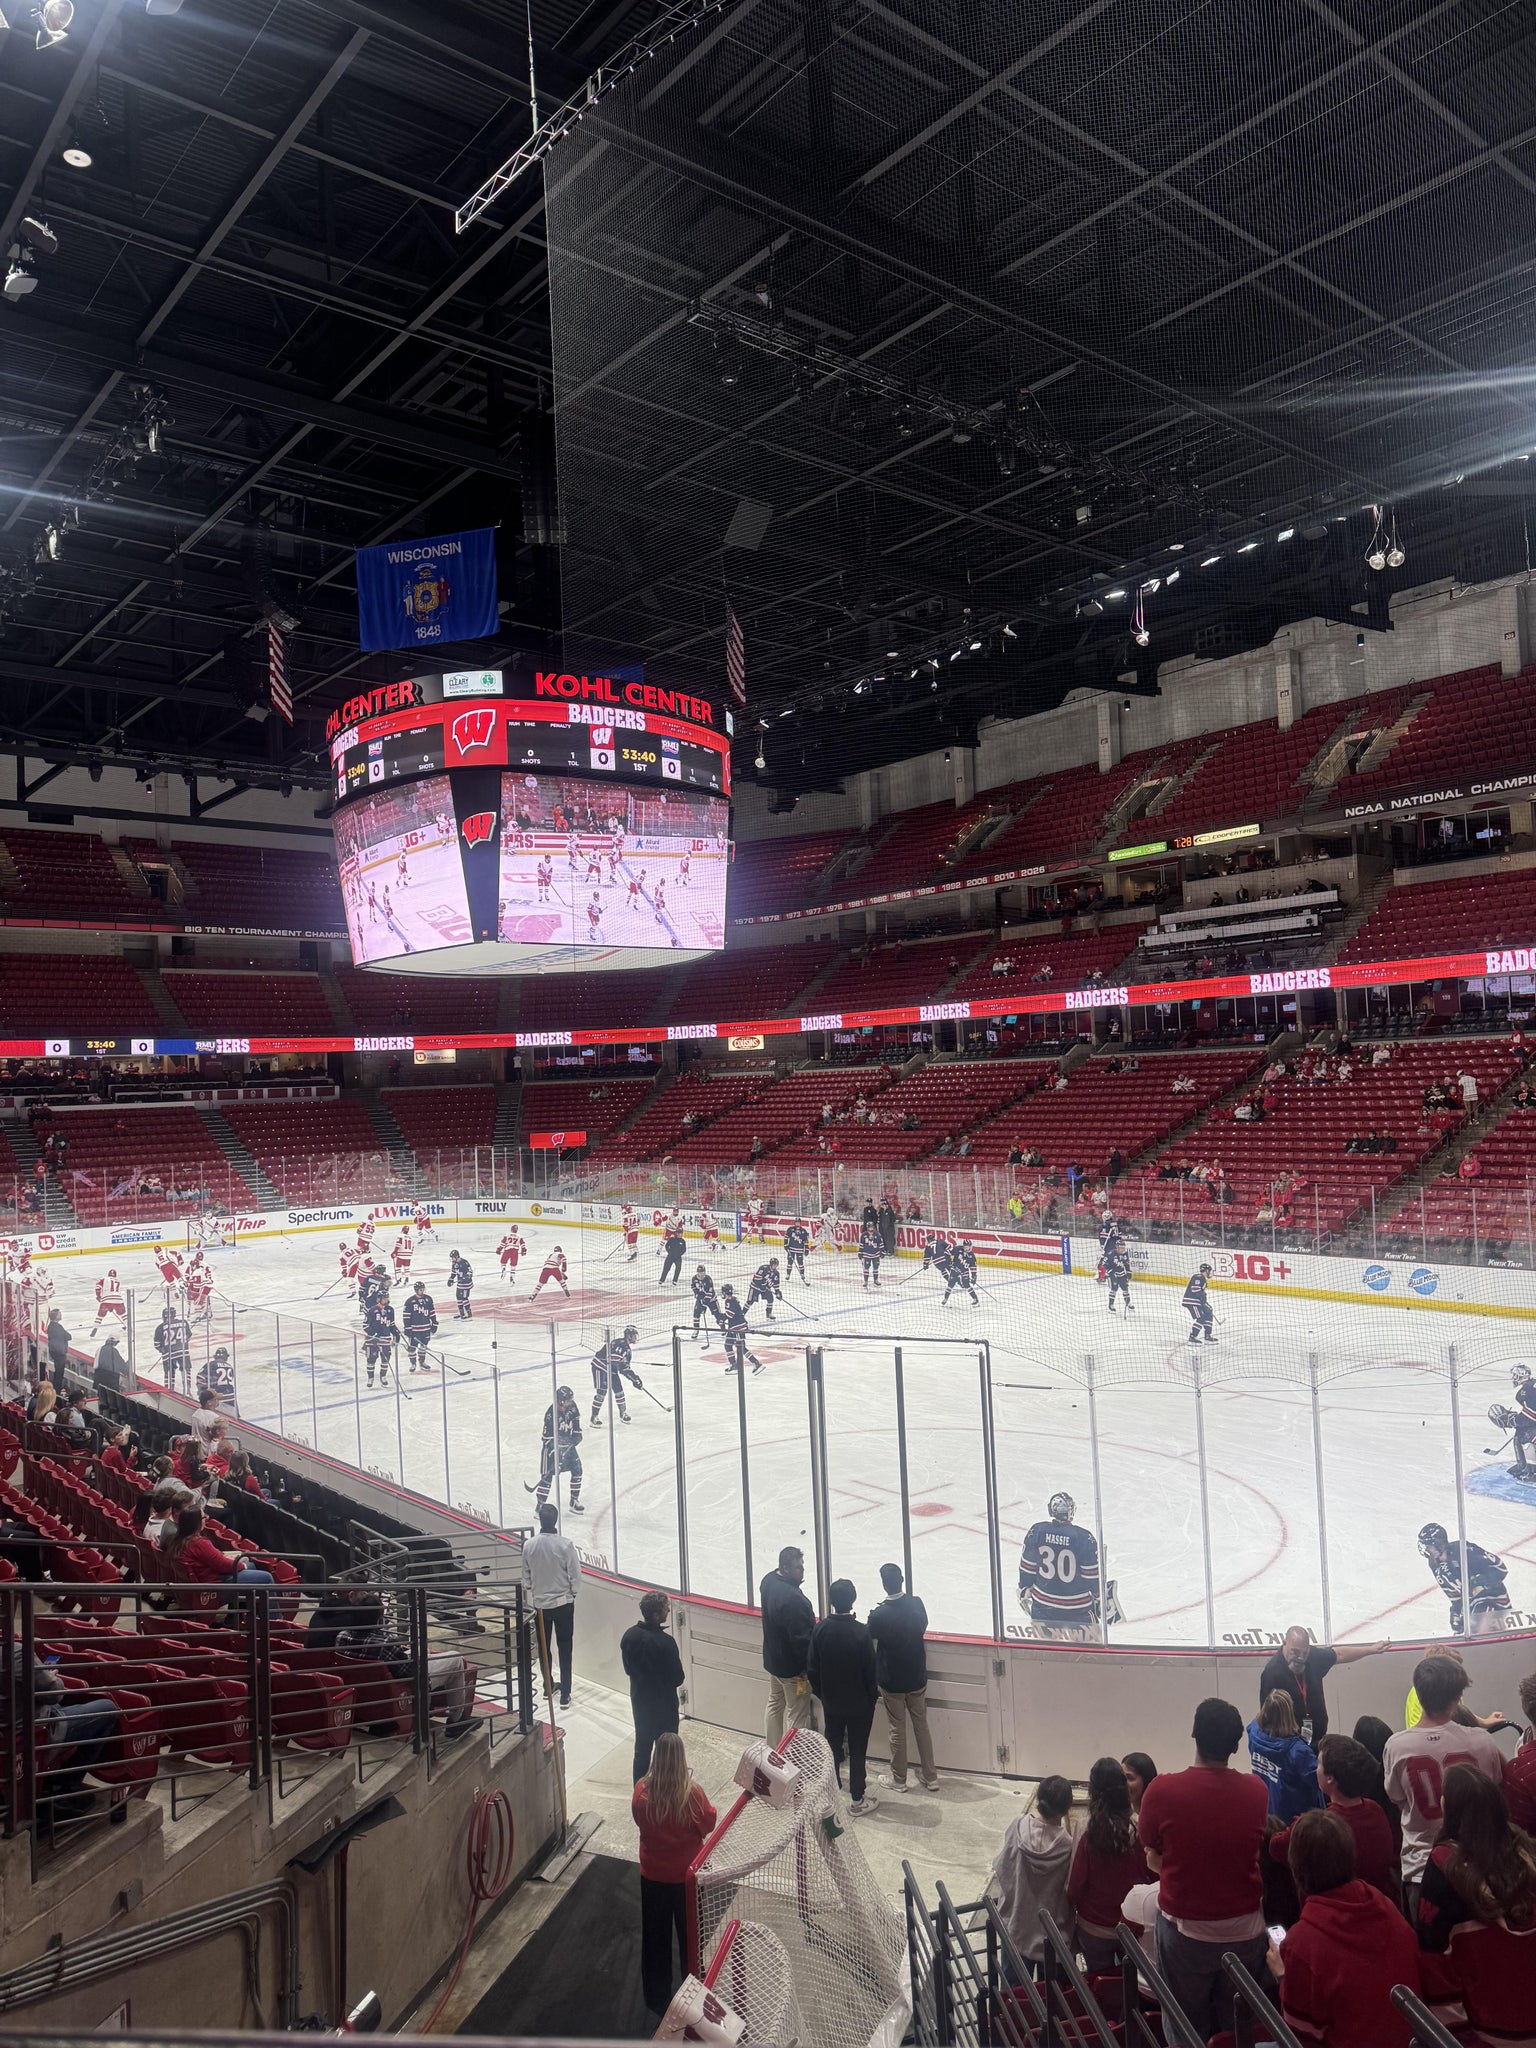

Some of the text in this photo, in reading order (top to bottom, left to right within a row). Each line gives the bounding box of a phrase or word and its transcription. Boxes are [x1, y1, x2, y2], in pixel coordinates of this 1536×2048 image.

[388, 541, 462, 564] WISCONSIN
[415, 624, 441, 639] 1848
[342, 680, 415, 723] CENTER
[535, 672, 713, 723] KOHL CENTER
[568, 704, 646, 731] BADGERS
[598, 752, 608, 765] 0
[622, 748, 656, 763] 33:40
[347, 763, 366, 779] 33:40
[373, 763, 380, 777] 0
[633, 763, 647, 772] 1ST
[668, 762, 676, 774] 0
[1345, 802, 1384, 818] NCAA
[1391, 788, 1464, 810] NATIONAL
[1174, 837, 1192, 848] 7:28
[734, 917, 754, 925] 1970
[994, 871, 1015, 882] 2010
[1021, 866, 1045, 877] 2026
[205, 926, 226, 934] TEN
[228, 927, 302, 937] TOURNAMENT
[1250, 968, 1331, 993] BADGERS
[1065, 987, 1129, 1009] BADGERS
[919, 1002, 970, 1021] BADGERS
[801, 1015, 842, 1032] BADGERS
[516, 1031, 572, 1046] BADGERS
[667, 1024, 717, 1039] BADGERS
[52, 1043, 62, 1053] 0
[86, 1040, 116, 1049] 33:40
[139, 1042, 148, 1052] 0
[216, 1039, 250, 1054] GERS
[354, 1037, 414, 1051] BADGERS
[734, 1038, 760, 1048] COUSINS
[475, 1202, 506, 1213] TRULY
[236, 1217, 267, 1230] TRIP
[288, 1210, 349, 1225] Spectrum
[112, 1231, 141, 1240] AMERICAN
[1127, 1249, 1149, 1260] lliant
[110, 1280, 121, 1292] 17
[1408, 1273, 1440, 1287] BLUE MOON
[413, 1304, 429, 1317] RMU
[1045, 1533, 1070, 1546] MASSIE
[1038, 1545, 1077, 1583] 30
[1252, 1751, 1282, 1774] BEST
